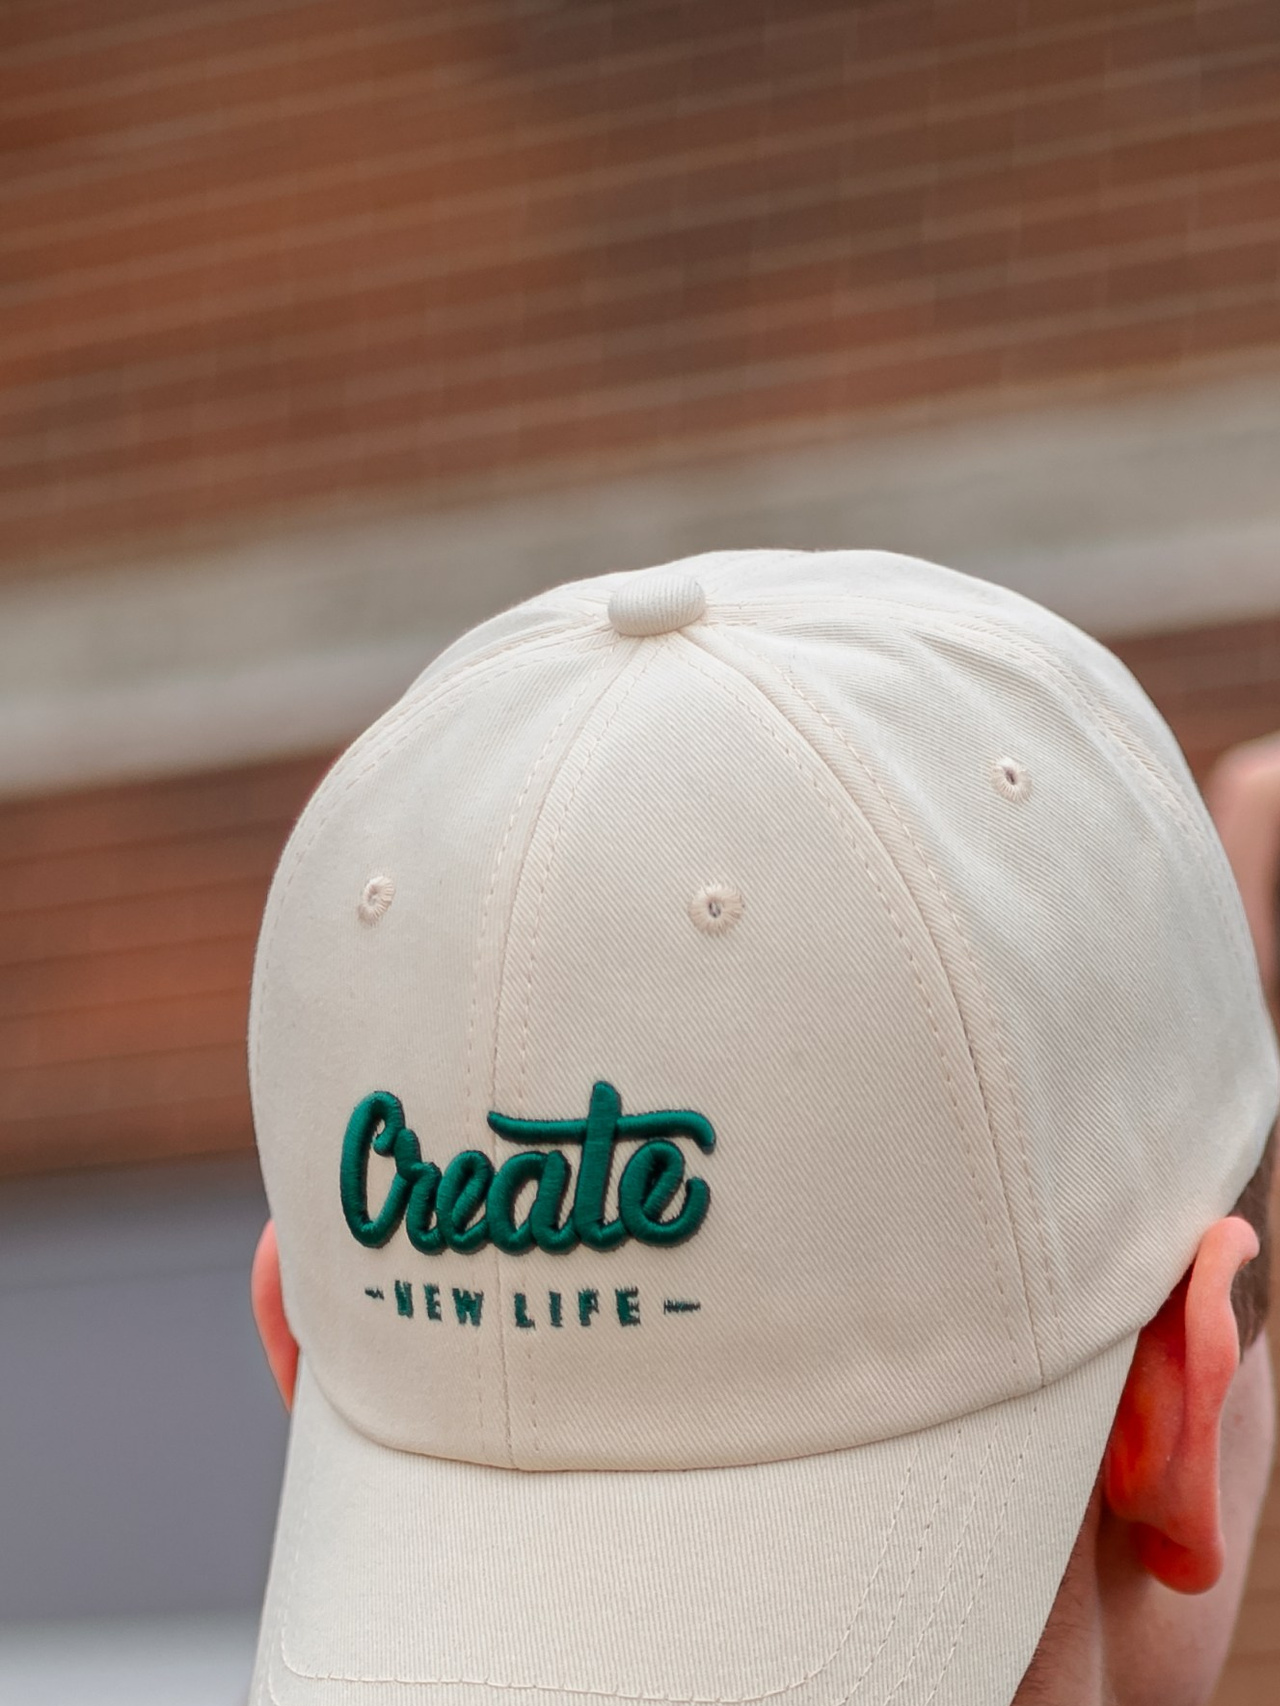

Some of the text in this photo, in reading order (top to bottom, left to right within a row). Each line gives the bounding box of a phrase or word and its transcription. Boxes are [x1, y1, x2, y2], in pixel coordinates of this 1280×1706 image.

[340, 1080, 717, 1256] Create
[394, 1279, 641, 1329] NEW LIFE
